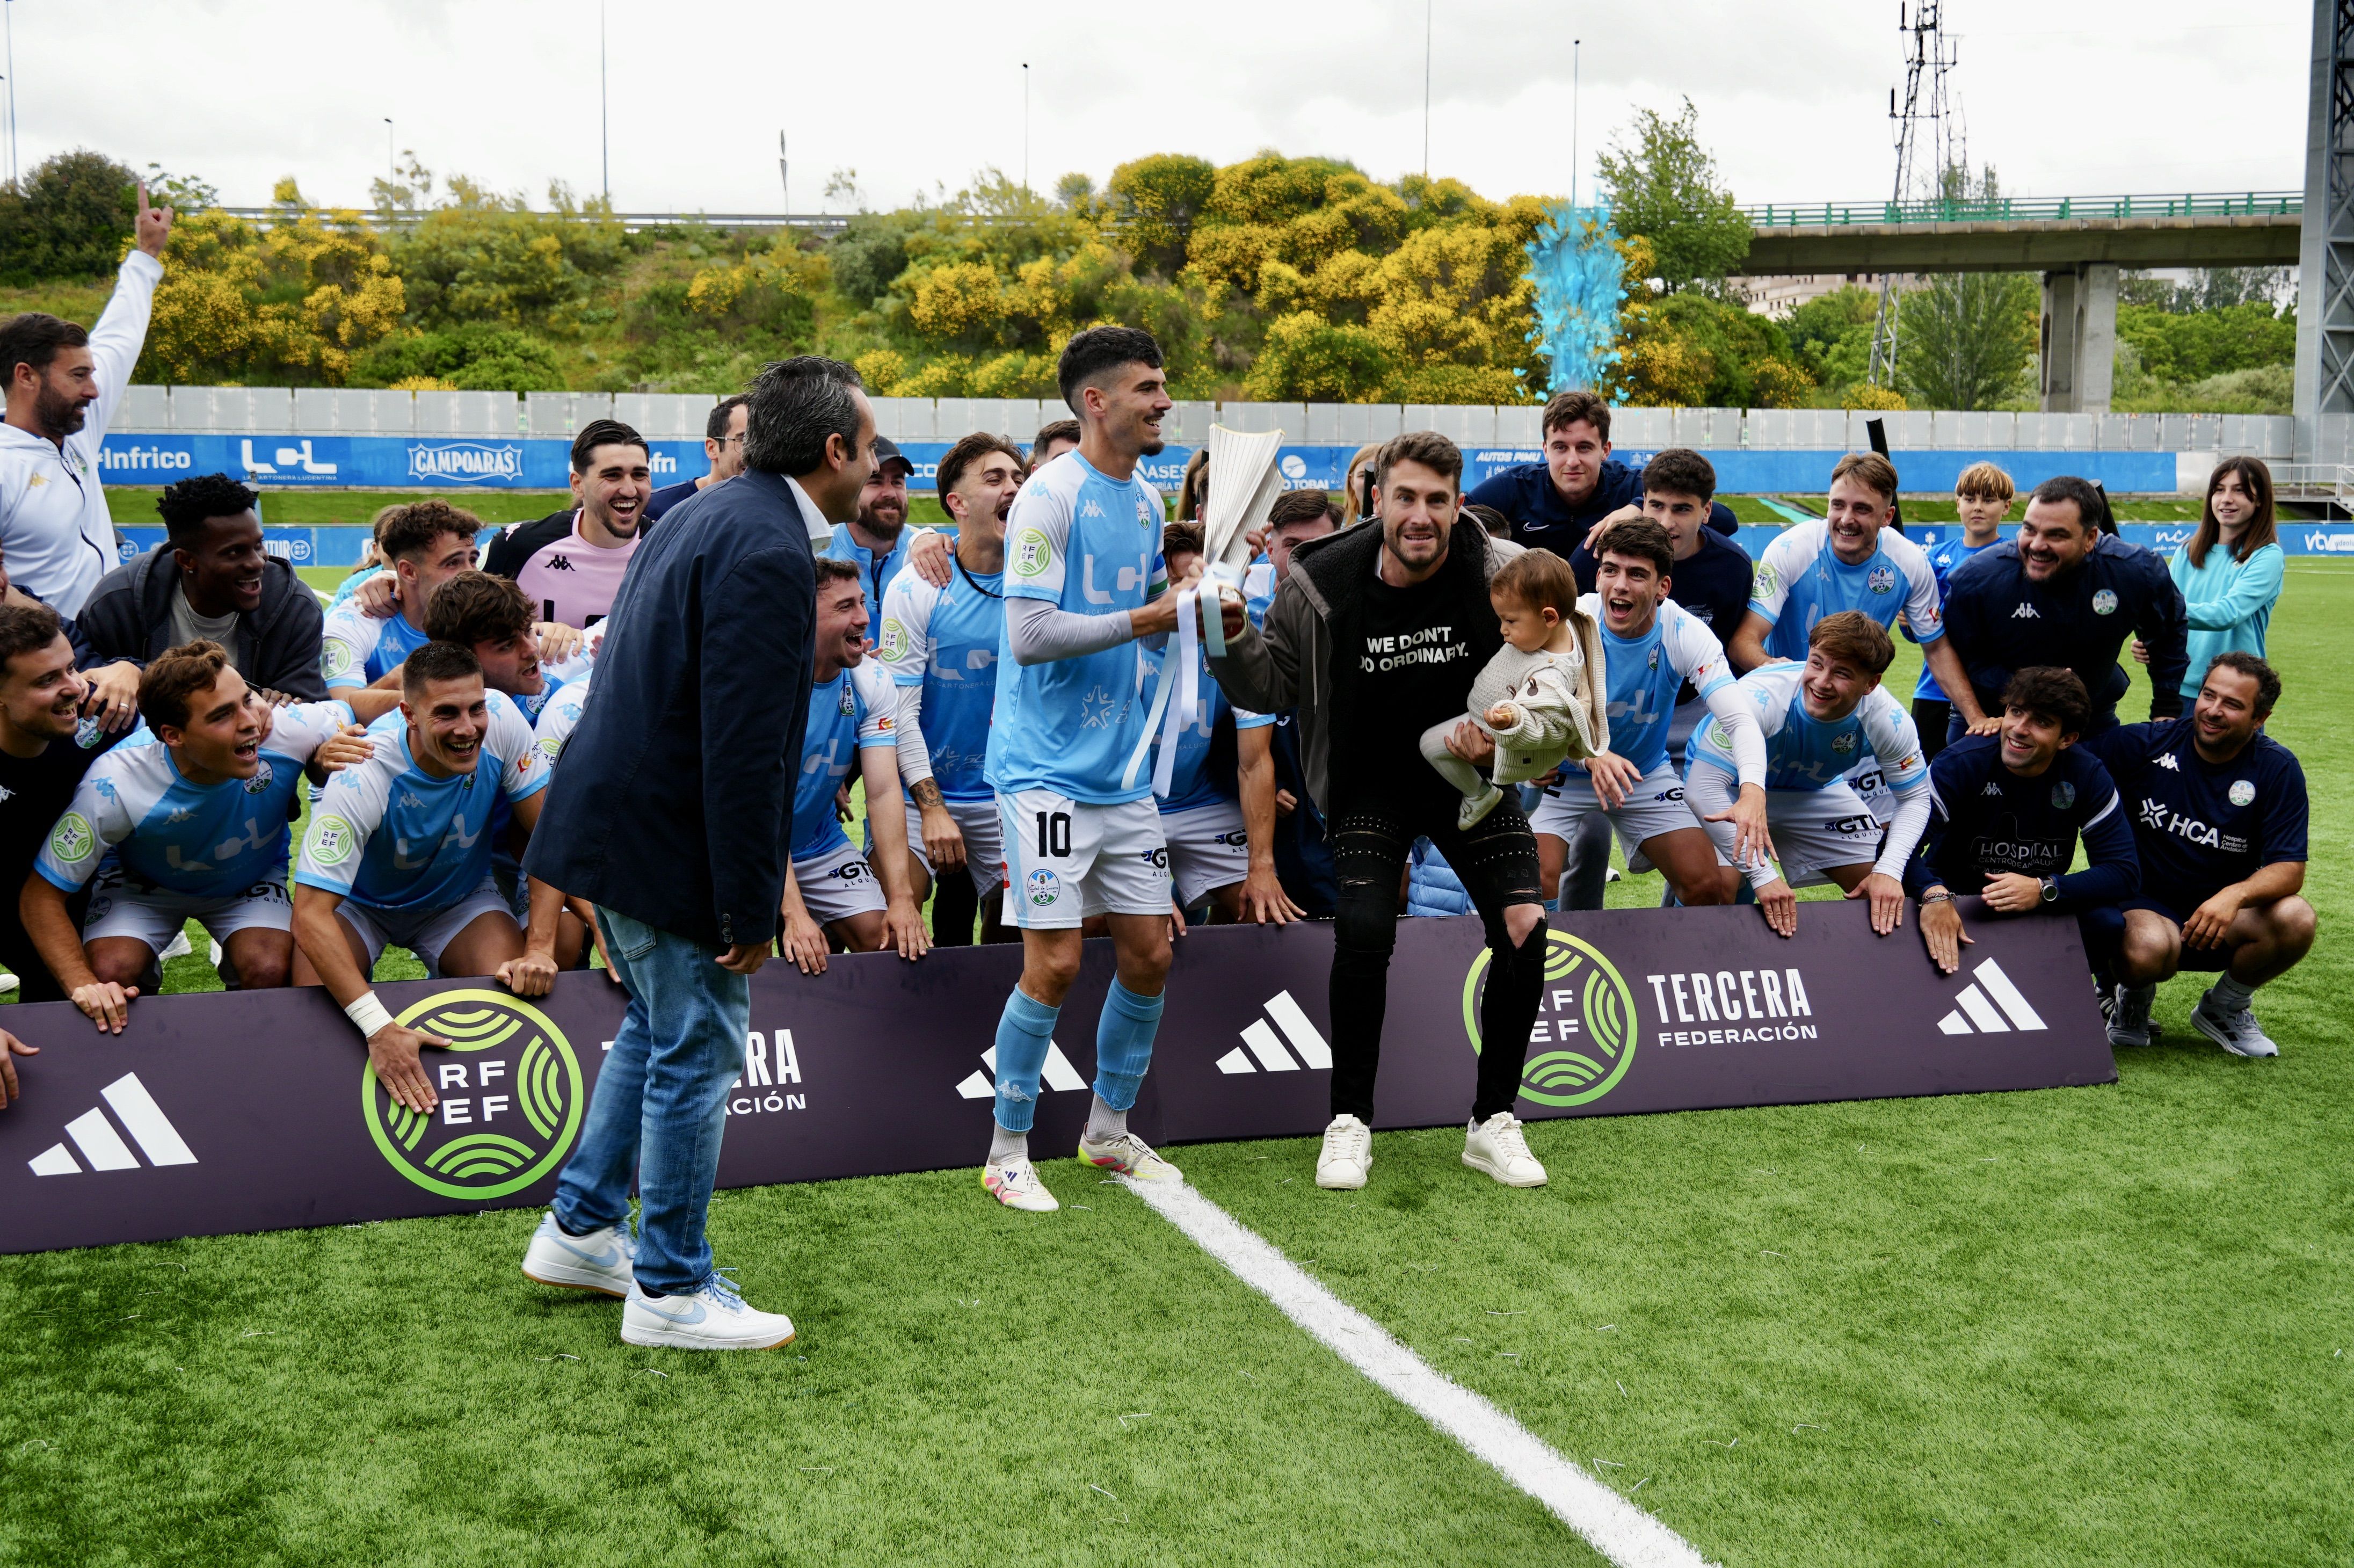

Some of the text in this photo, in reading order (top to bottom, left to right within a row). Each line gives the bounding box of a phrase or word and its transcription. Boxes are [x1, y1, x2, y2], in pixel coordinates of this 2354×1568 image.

[415, 450, 515, 473] CAMPOARAS
[1367, 636, 1395, 653] WE
[1379, 642, 1469, 671] ORDINARY.
[324, 831, 338, 839] RF
[1036, 811, 1071, 857] 10
[2168, 813, 2219, 848] HCA
[1980, 843, 2063, 860] HOSPITAL
[1646, 968, 1812, 1023] TERCERA
[1529, 1019, 1579, 1043] EF
[1659, 1021, 1818, 1047] FEDERACIÓN
[439, 1060, 506, 1090] RF
[443, 1095, 509, 1125] EF
